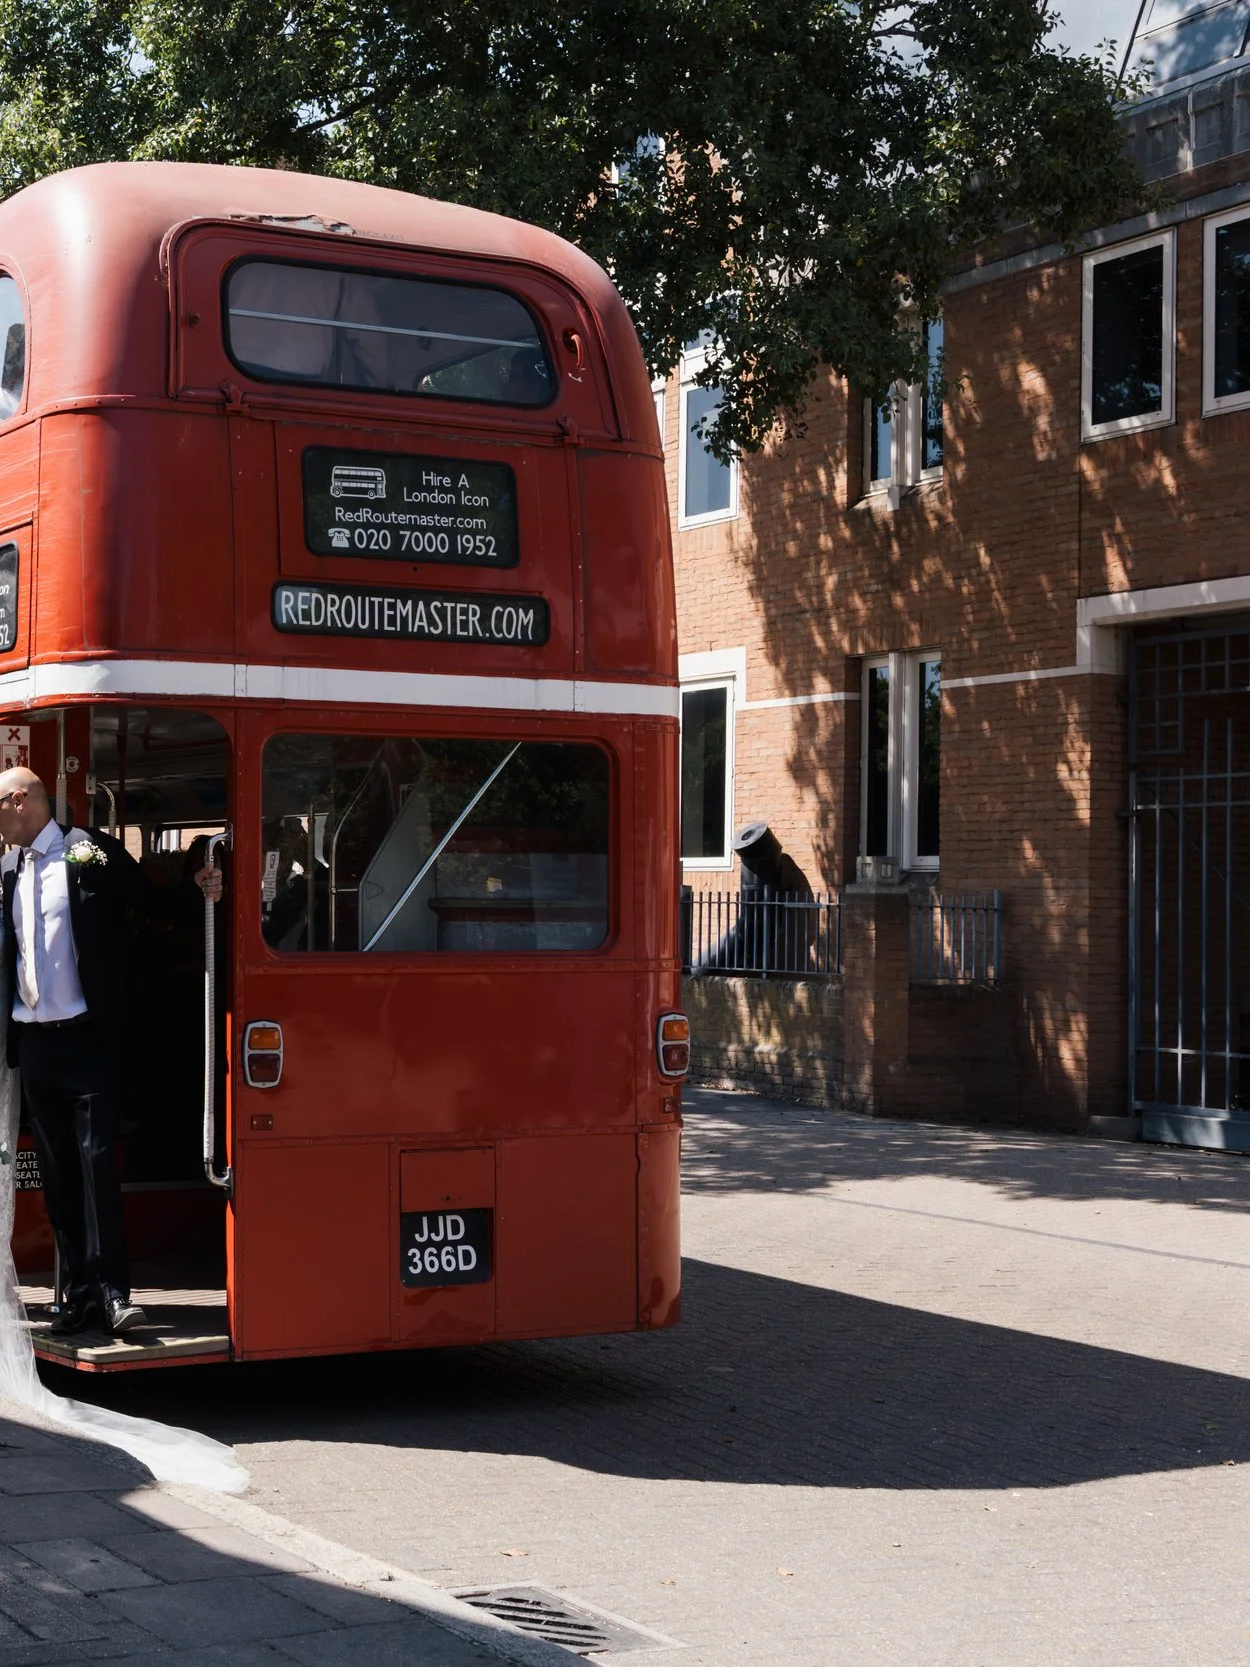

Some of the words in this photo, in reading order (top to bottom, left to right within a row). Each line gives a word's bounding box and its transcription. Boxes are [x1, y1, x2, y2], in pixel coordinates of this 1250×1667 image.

[422, 471, 452, 488] Hire
[457, 473, 470, 489] A
[403, 486, 456, 505] London
[461, 491, 490, 507] Icon
[334, 507, 487, 530] RedRoutemaster.com
[354, 528, 391, 550] 020
[399, 530, 449, 554] 7000
[456, 534, 497, 557] 1952
[280, 590, 535, 641] REDROUTEMASTER.COM
[24, 1180, 42, 1189] SAL
[414, 1214, 465, 1243] JJD
[407, 1244, 477, 1274] 366D
